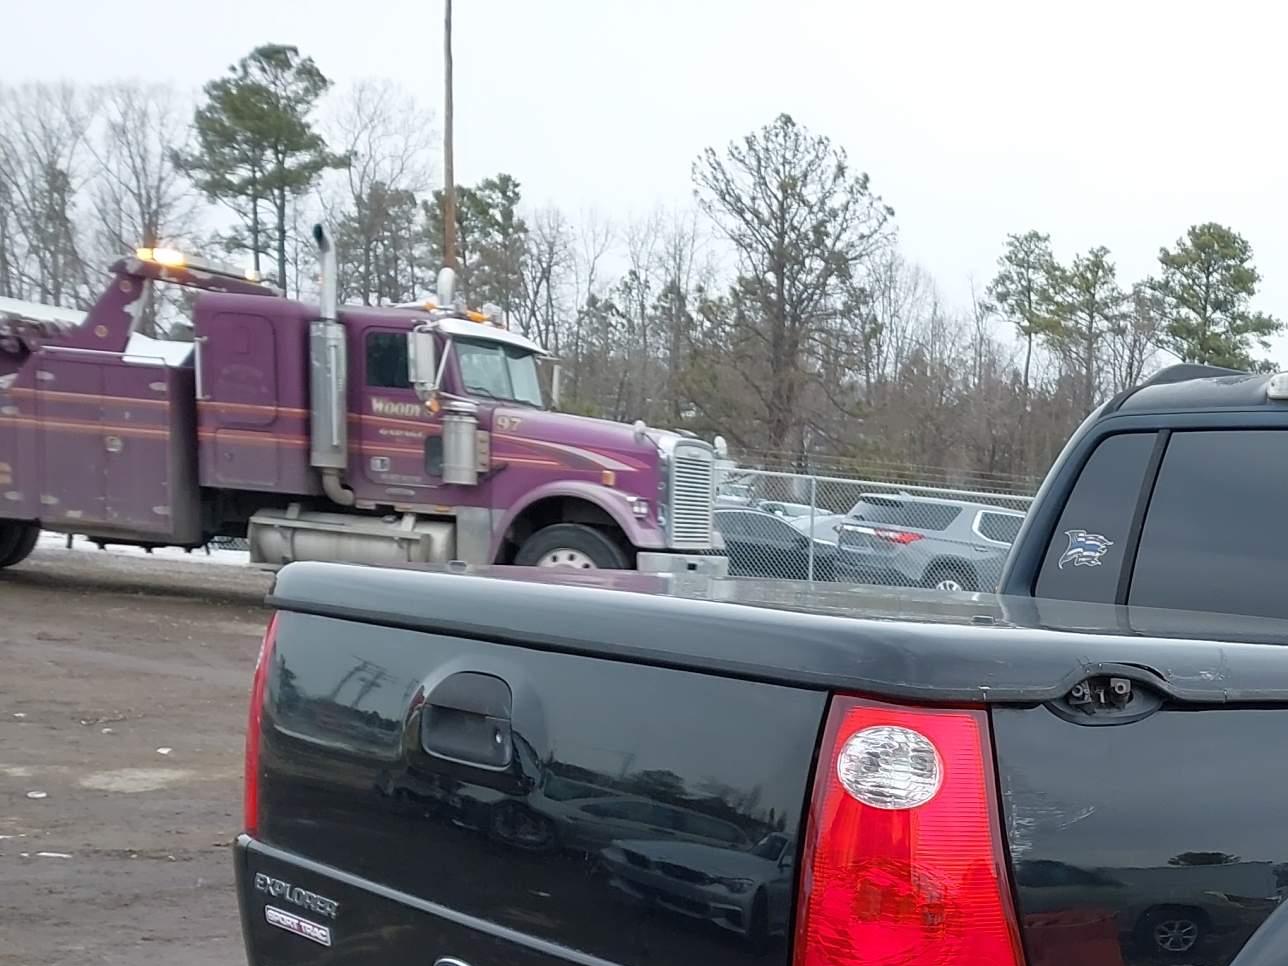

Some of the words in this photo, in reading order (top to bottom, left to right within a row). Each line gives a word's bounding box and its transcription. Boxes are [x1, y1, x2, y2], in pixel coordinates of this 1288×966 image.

[496, 415, 522, 432] 97
[255, 872, 338, 920] EXPLORER
[266, 909, 300, 929] SPORT
[300, 921, 328, 942] TRAC
